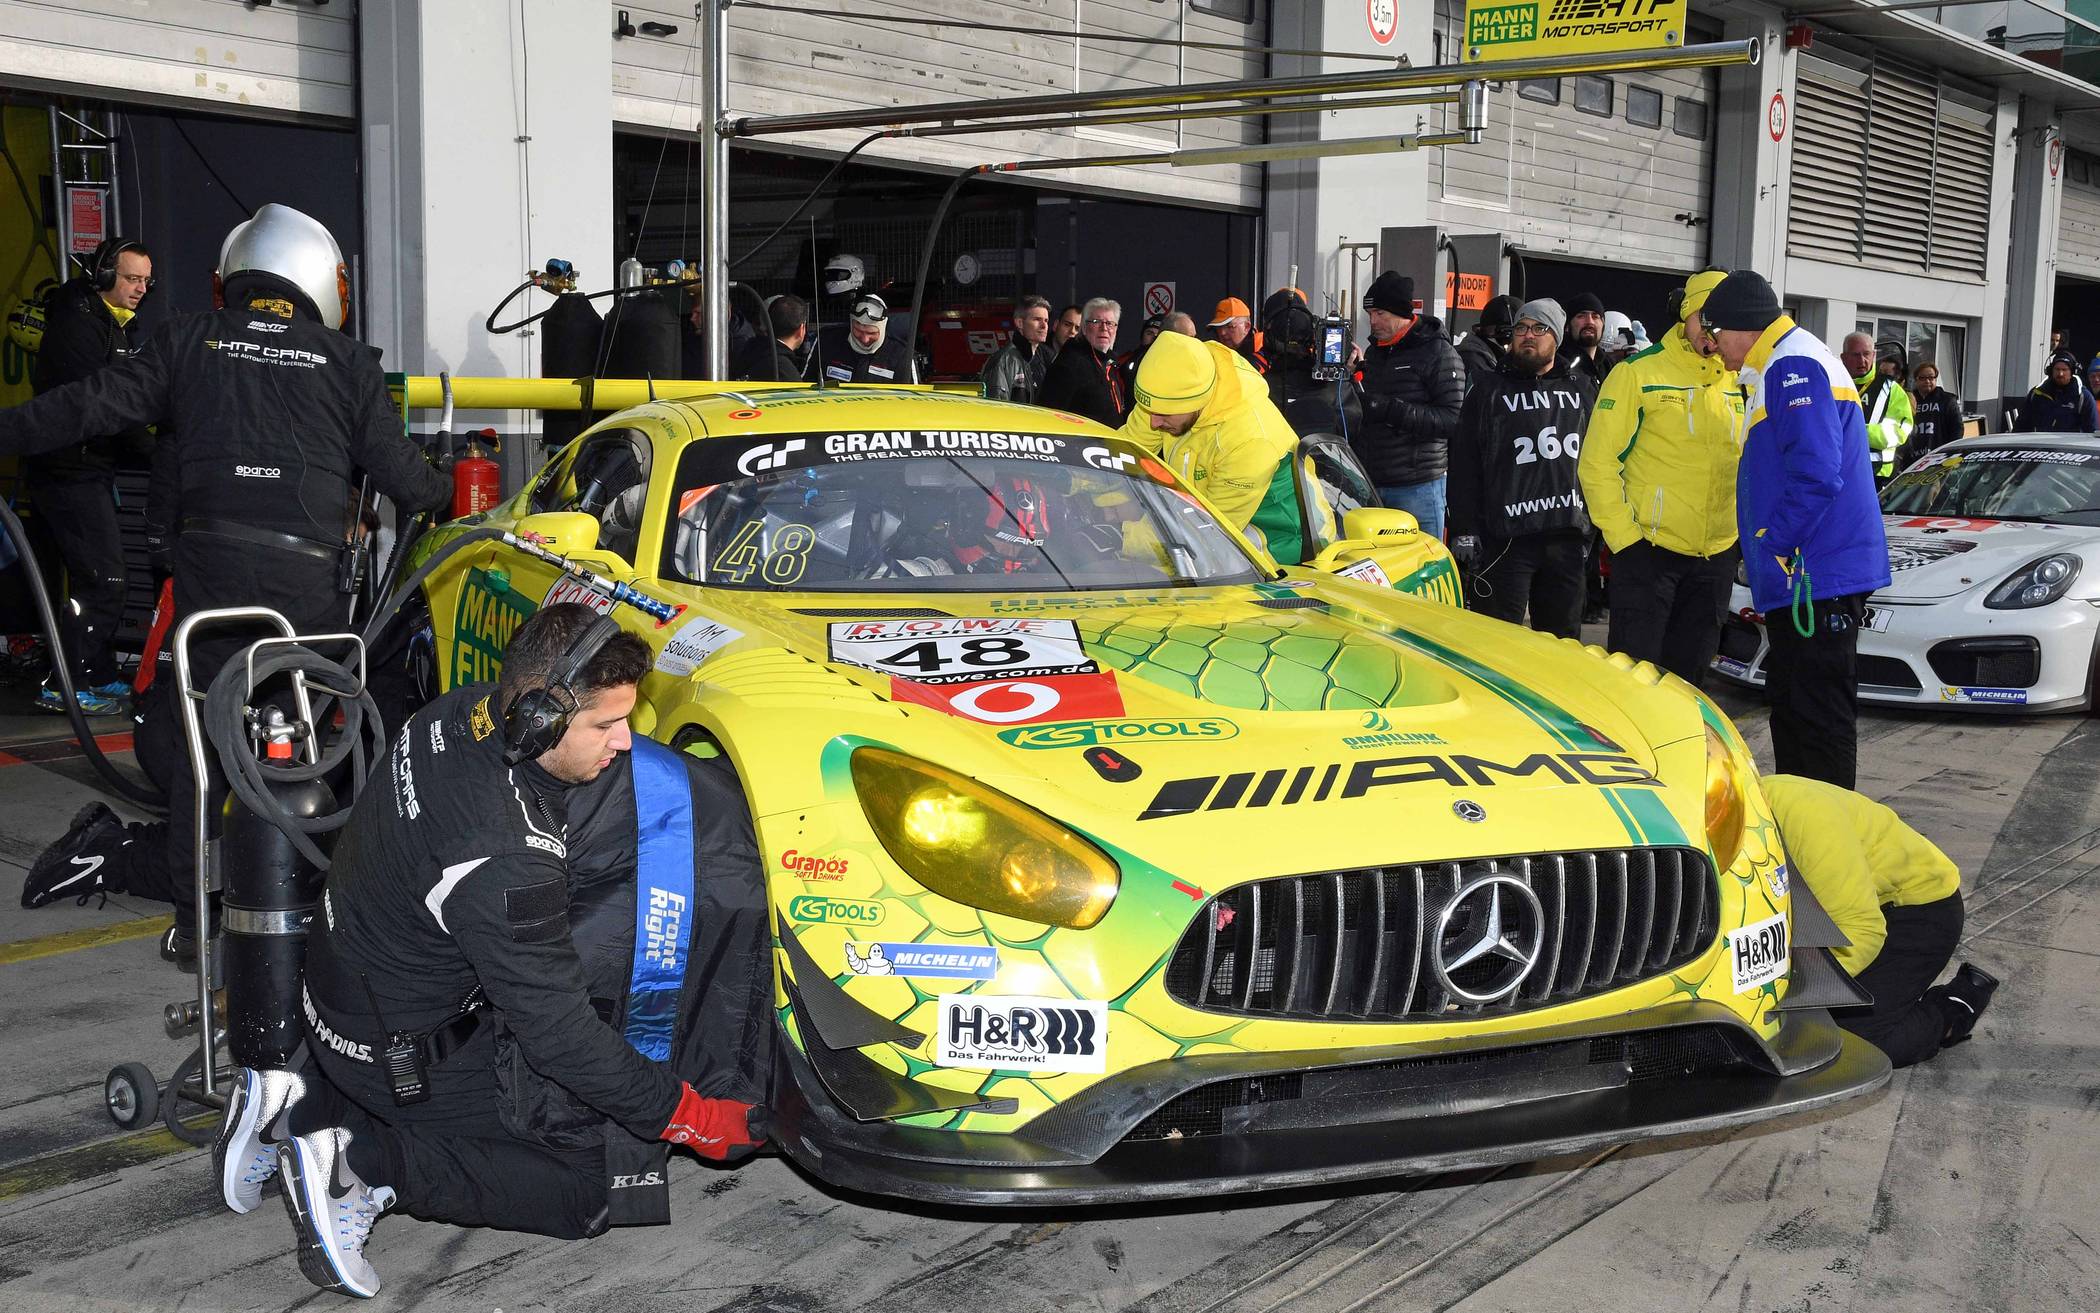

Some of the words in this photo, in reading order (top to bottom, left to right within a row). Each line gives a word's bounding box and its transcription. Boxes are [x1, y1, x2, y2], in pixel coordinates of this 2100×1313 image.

[1473, 6, 1534, 27] MANN
[1473, 23, 1533, 42] FILTER
[1542, 18, 1668, 39] MOTORSPORT
[1446, 276, 1487, 292] MNDORF
[1458, 294, 1476, 308] ANK
[218, 340, 261, 352] HTP
[263, 347, 328, 365] CARS
[240, 352, 279, 365] AUTOMOTIVE
[279, 360, 316, 369] EXPERIENCE
[1502, 390, 1551, 412] VLN
[1553, 390, 1580, 410] TV
[1916, 402, 1940, 413] EDIA
[824, 431, 912, 455] GRAN
[831, 453, 864, 463] THE
[867, 451, 908, 459] REAL
[911, 449, 976, 458] DRIVING
[977, 450, 1061, 463] SIMULATOR
[235, 465, 281, 478] sparco
[1395, 528, 1417, 536] AMG
[712, 520, 816, 586] 48
[849, 619, 1047, 635] ROWE
[664, 640, 709, 661] solutions
[875, 637, 1032, 673] 48
[1970, 690, 2026, 700] MICHELIN
[1014, 725, 1090, 746] KS
[1093, 722, 1222, 739] TOOLS
[1341, 733, 1441, 746] OMNILINK
[1350, 742, 1387, 750] Green
[1340, 753, 1667, 799] AMG
[400, 757, 421, 820] CARS
[793, 870, 814, 879] SOFT
[817, 872, 845, 882] DRINKS
[793, 899, 827, 914] KS
[826, 902, 879, 922] TOOLS
[644, 886, 667, 962] Right
[662, 891, 686, 969] Front
[894, 951, 993, 969] MICHELIN
[1735, 929, 1773, 976] H&R
[1738, 977, 1749, 986] Das
[949, 1004, 1044, 1051] H&R
[948, 1050, 974, 1060] Das
[977, 1051, 1046, 1063] Fahrwerk!
